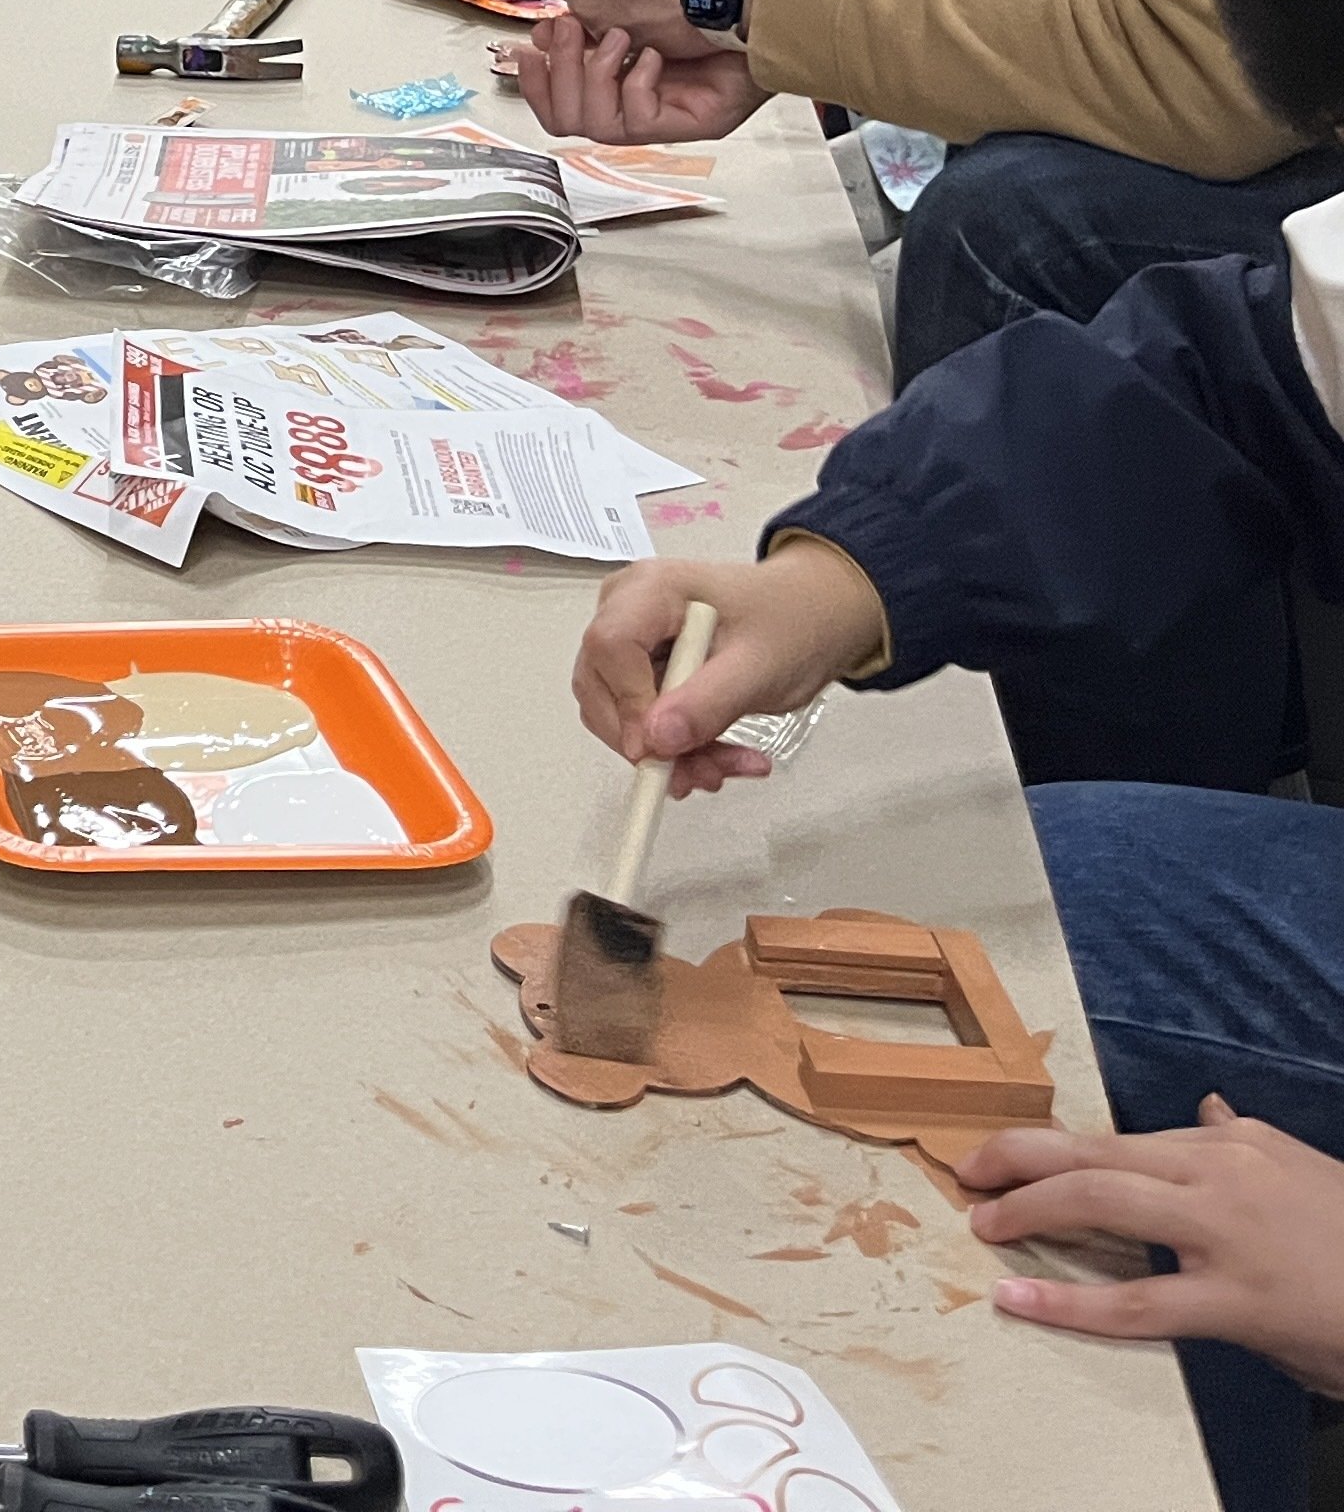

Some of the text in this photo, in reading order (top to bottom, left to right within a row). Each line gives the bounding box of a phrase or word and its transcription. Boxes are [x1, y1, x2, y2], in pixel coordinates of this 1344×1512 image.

[192, 386, 233, 471] HEATING OR
[243, 456, 277, 495] A/C
